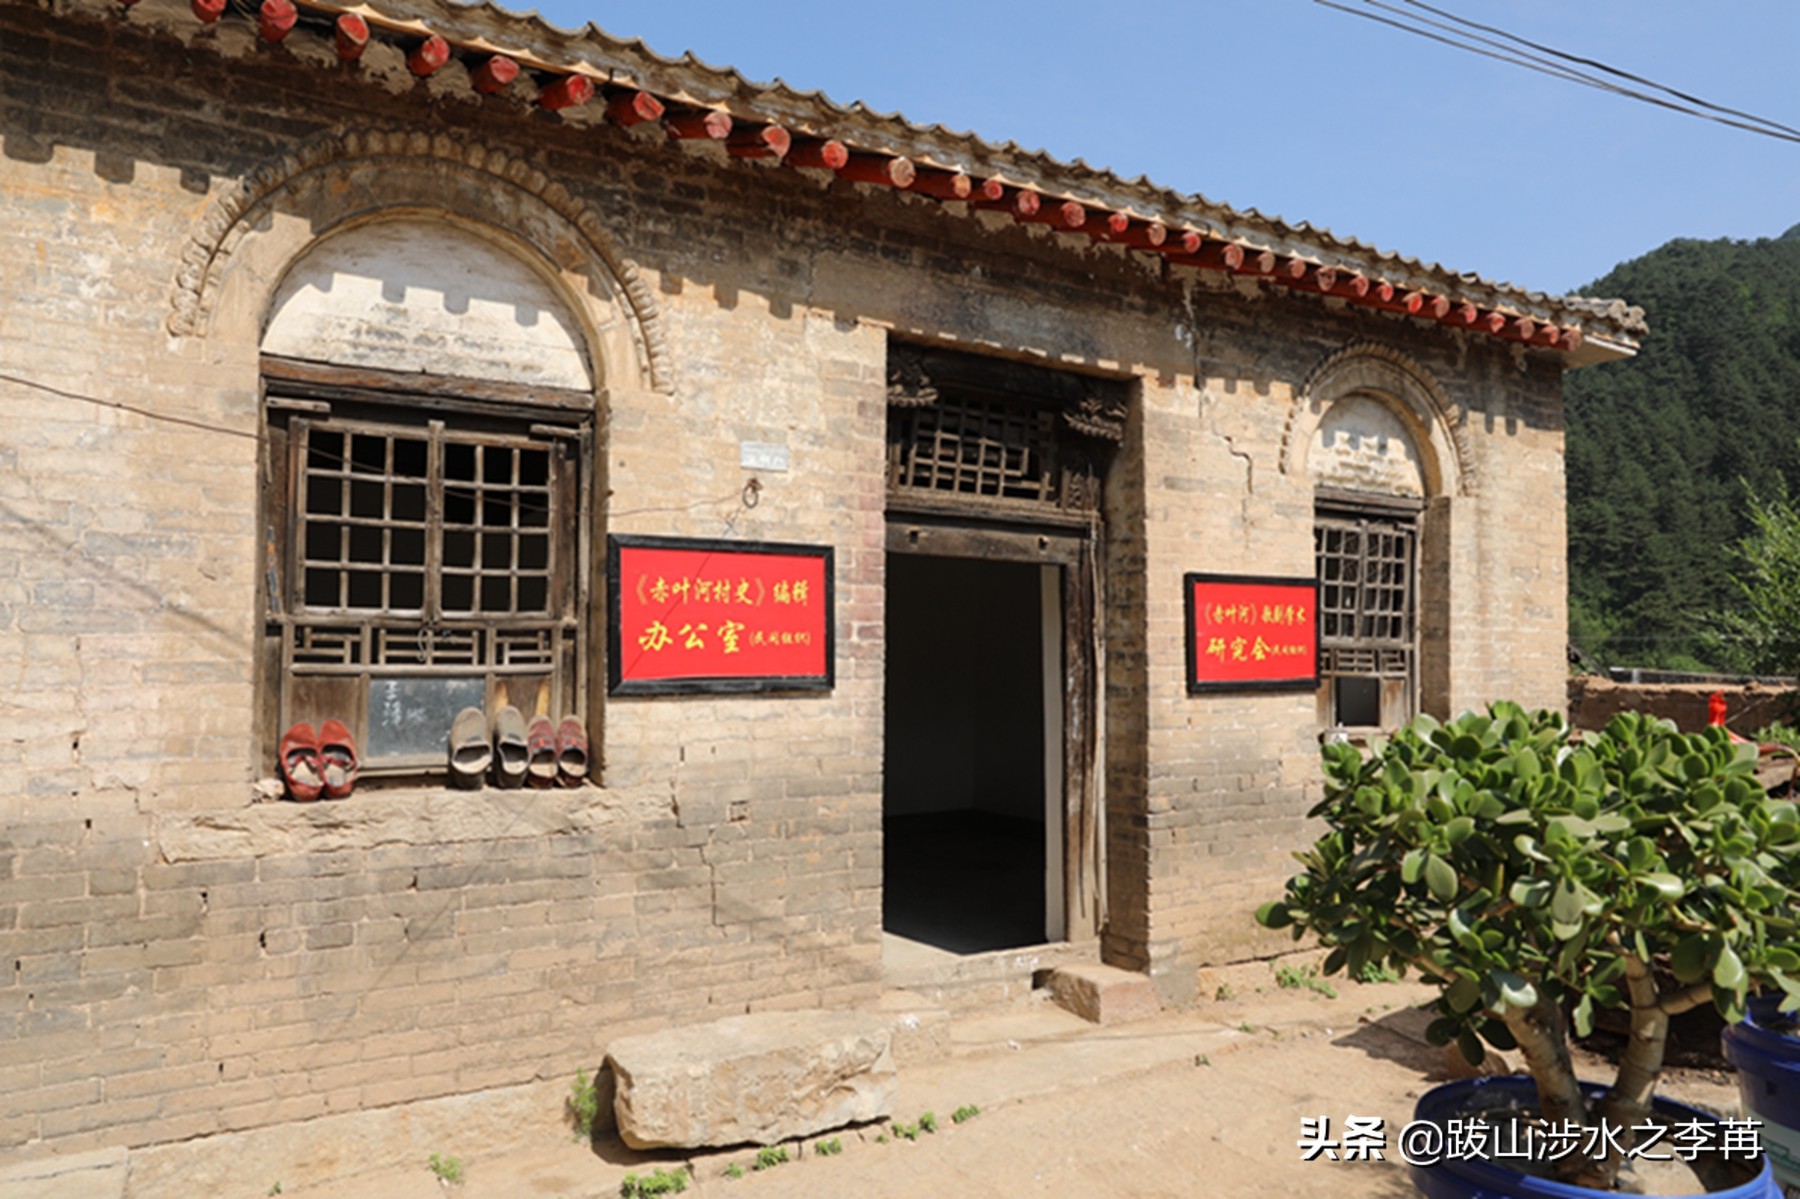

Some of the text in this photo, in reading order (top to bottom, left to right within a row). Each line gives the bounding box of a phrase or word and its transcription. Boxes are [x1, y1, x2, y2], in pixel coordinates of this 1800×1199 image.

[635, 573, 810, 606] 《赤叶河村史》编辑
[638, 619, 746, 654] 办公室
[1205, 635, 1271, 663] 研究会
